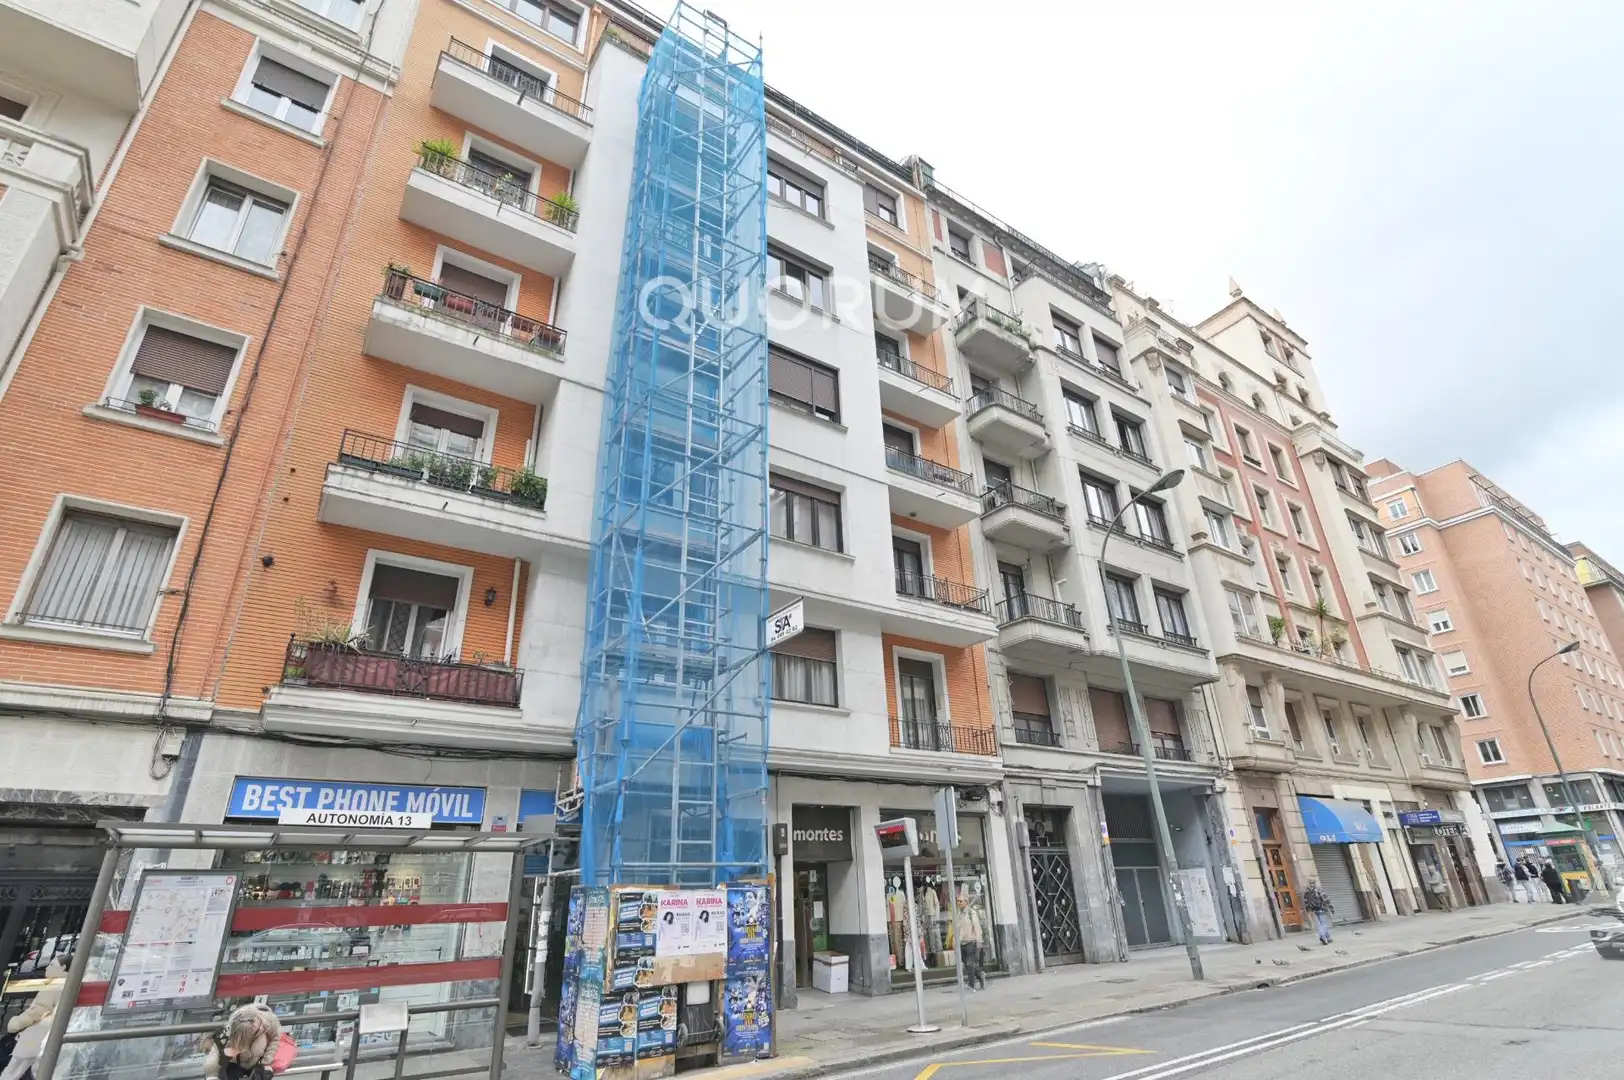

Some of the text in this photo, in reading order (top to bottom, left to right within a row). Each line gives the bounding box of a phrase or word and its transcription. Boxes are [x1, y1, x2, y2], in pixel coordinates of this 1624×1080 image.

[242, 784, 473, 818] BEST PHONE MÓVIL
[306, 812, 412, 827] AUTONOMÍA 13
[793, 827, 844, 842] montes
[660, 898, 688, 907] KARINA
[696, 897, 723, 906] KARINA
